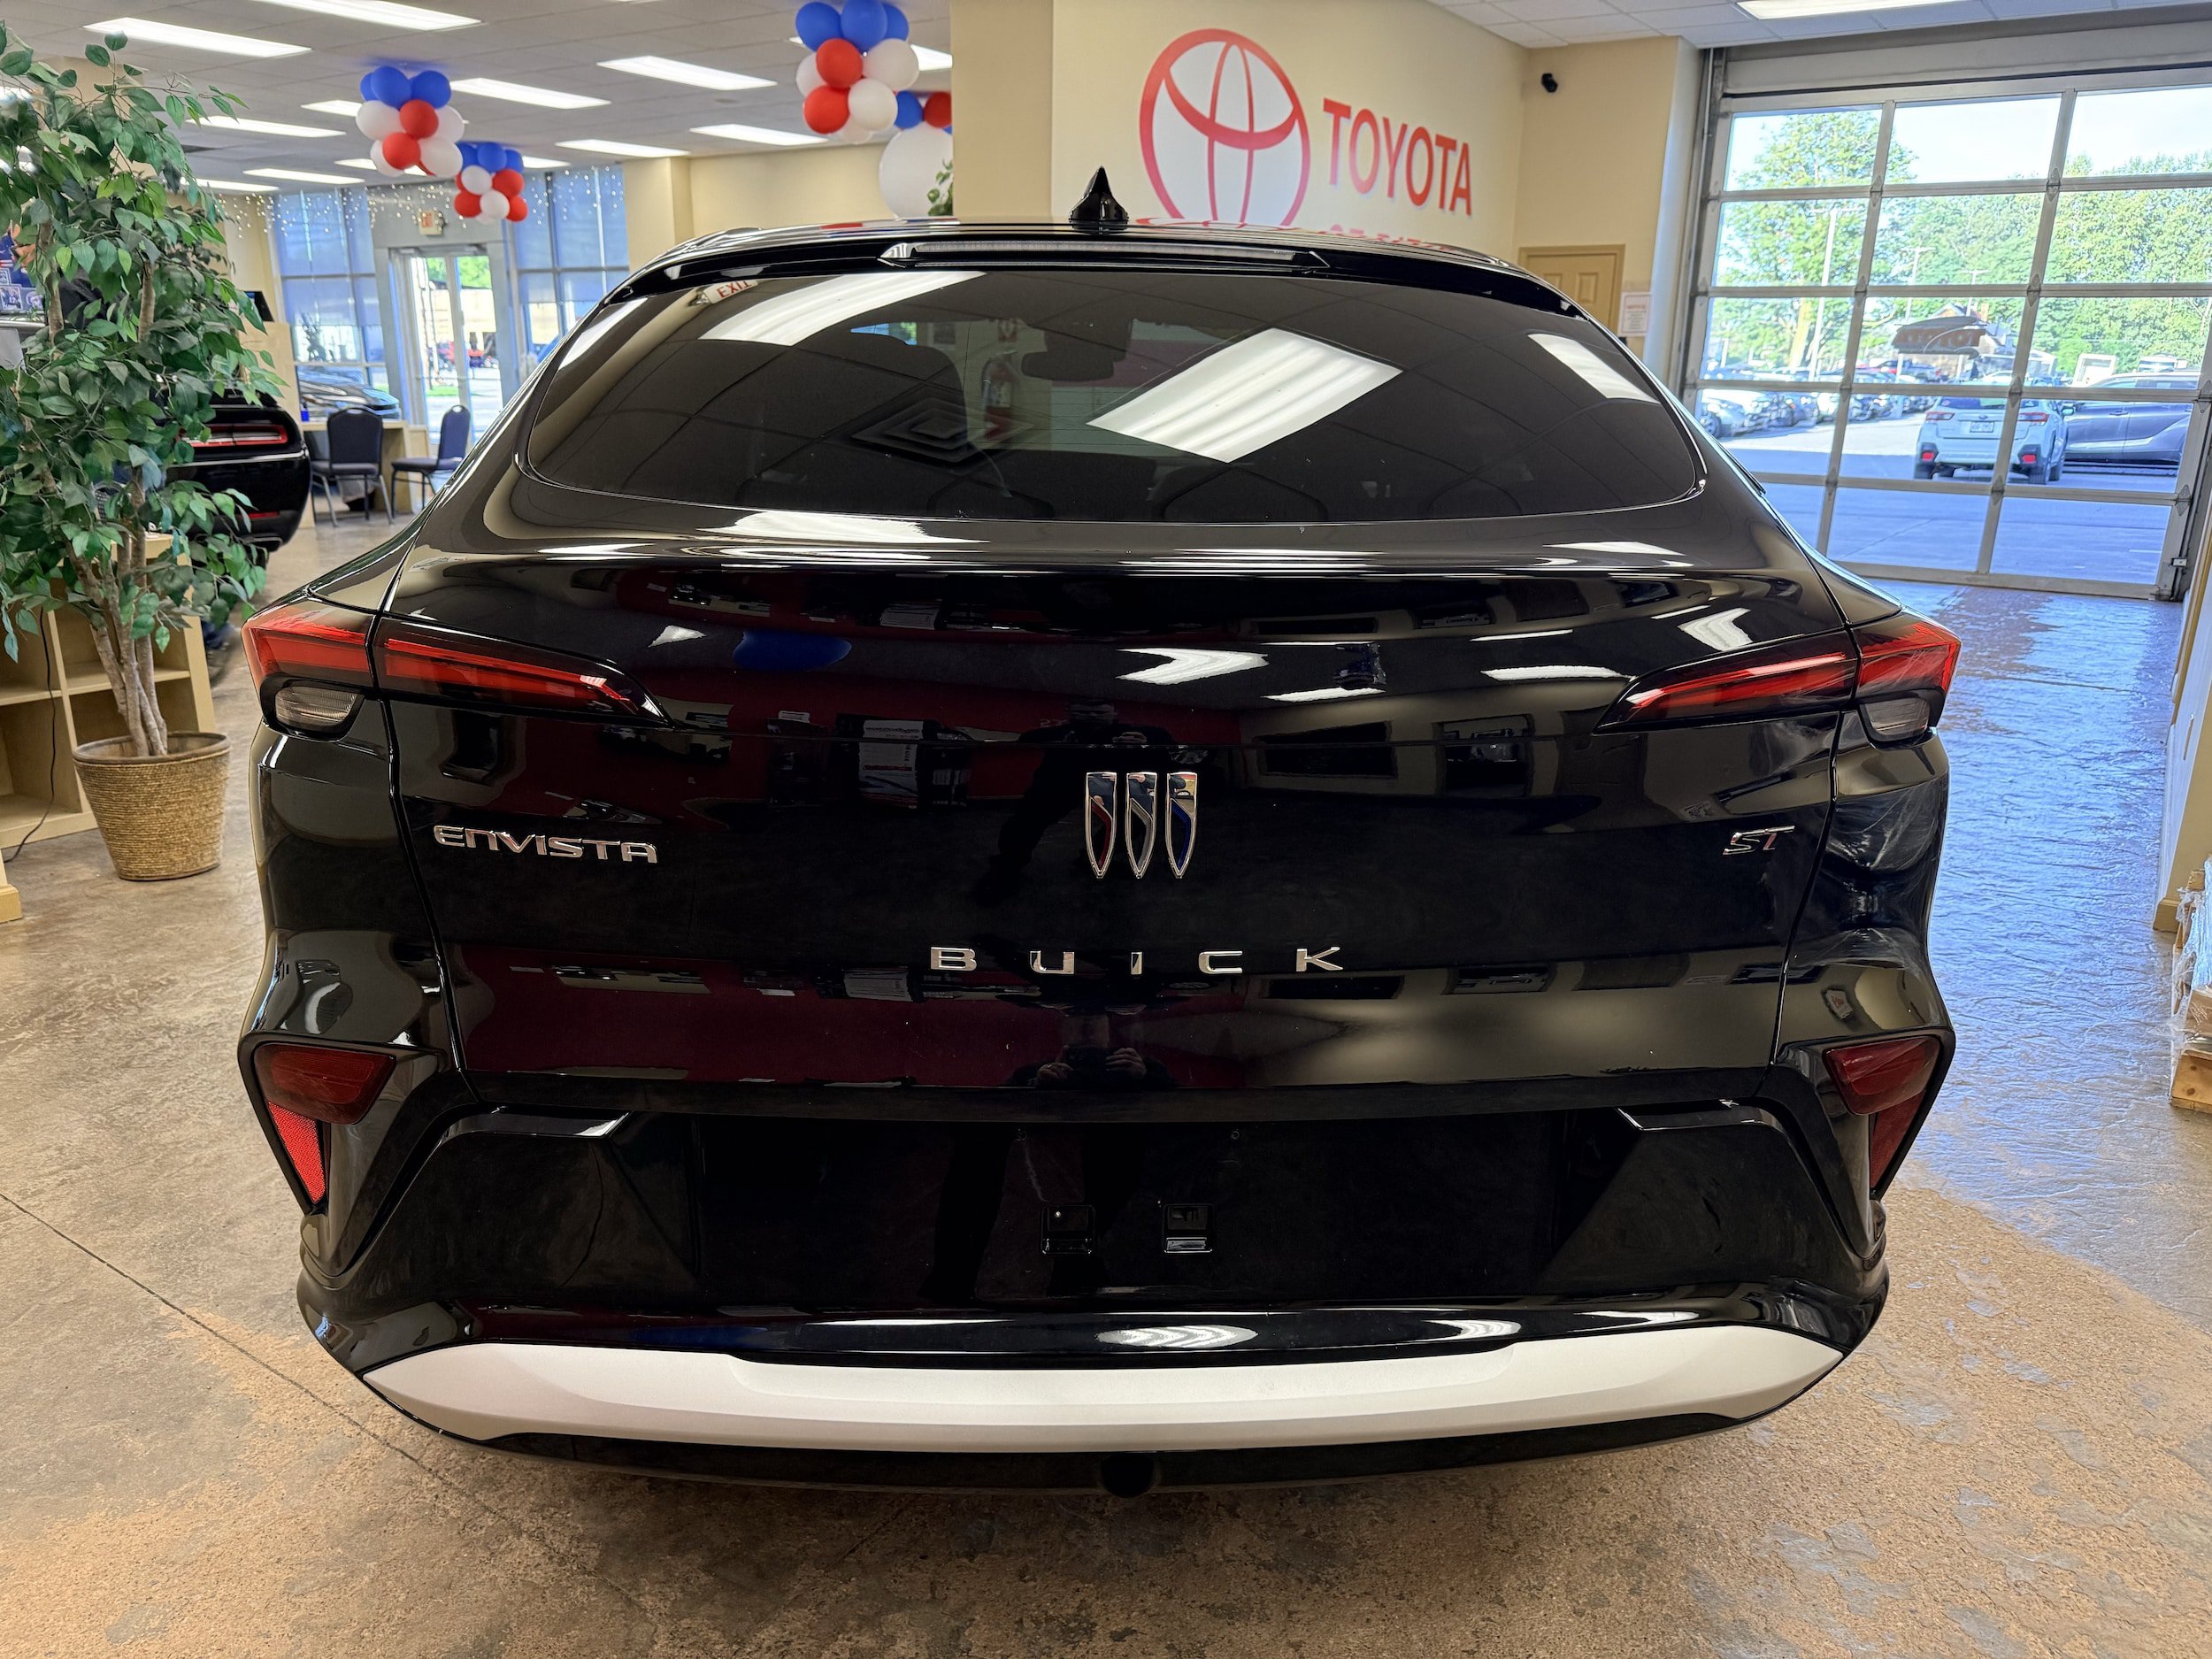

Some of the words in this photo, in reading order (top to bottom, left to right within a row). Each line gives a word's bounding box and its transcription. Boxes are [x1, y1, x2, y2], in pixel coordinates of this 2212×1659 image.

[1324, 97, 1471, 217] TOYOTA
[434, 825, 658, 864] ENVISTA
[1722, 825, 1795, 856] ST
[930, 946, 1344, 974] BUICK
